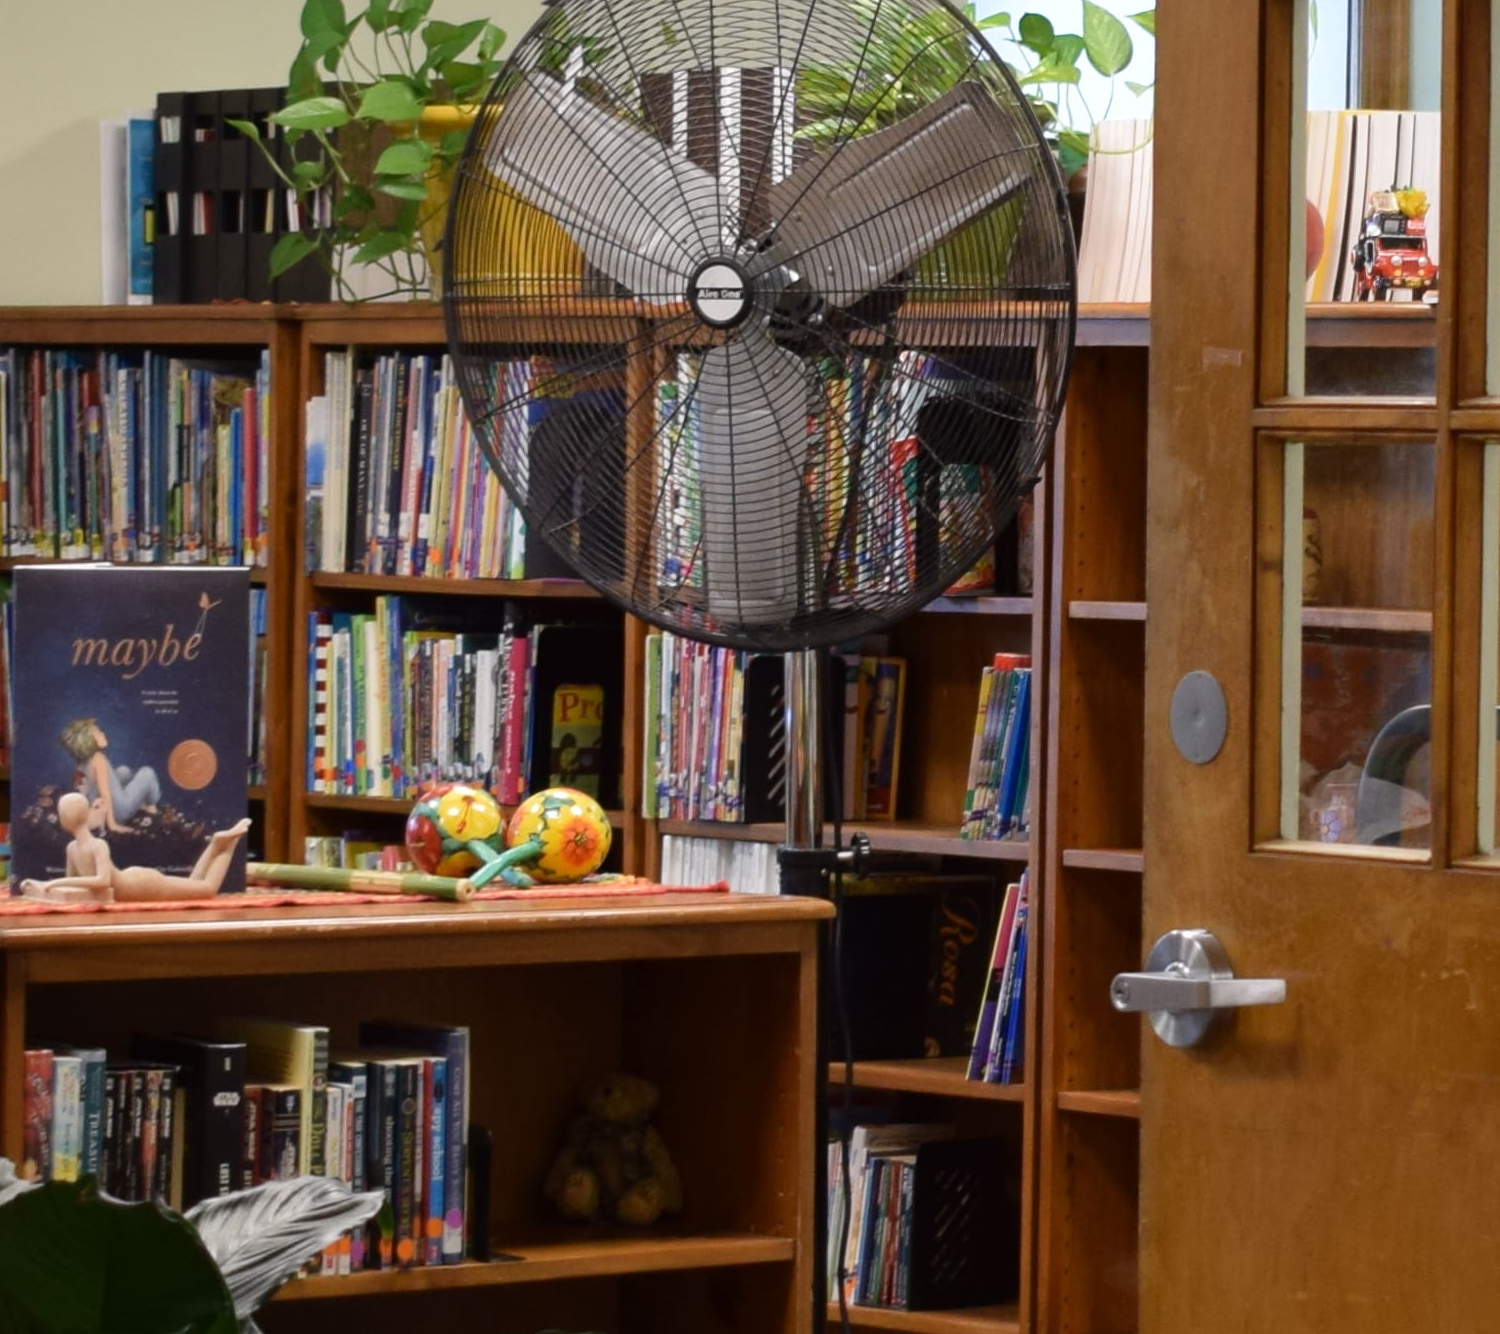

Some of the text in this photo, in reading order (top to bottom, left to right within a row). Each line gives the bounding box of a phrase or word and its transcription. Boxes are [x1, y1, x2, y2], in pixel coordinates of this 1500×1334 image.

[71, 623, 202, 681] maybe
[87, 1111, 102, 1173] TREASU
[431, 1107, 444, 1181] spy school
